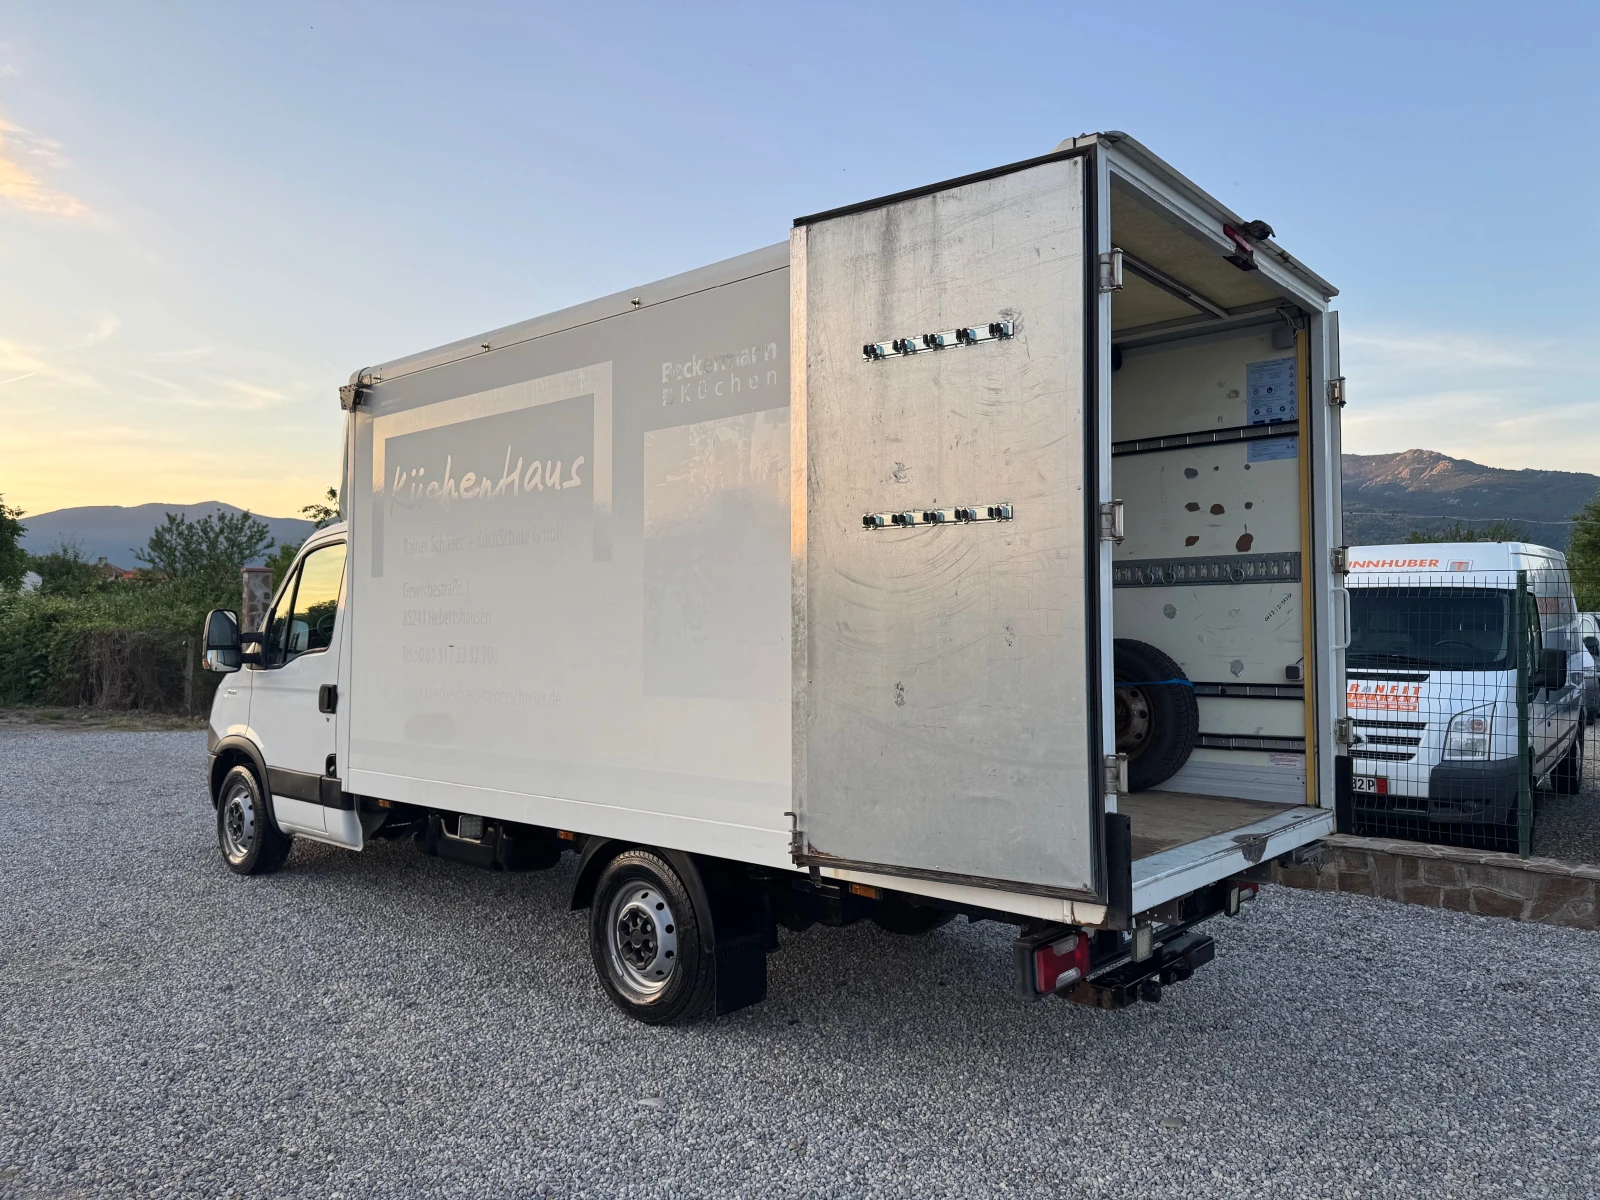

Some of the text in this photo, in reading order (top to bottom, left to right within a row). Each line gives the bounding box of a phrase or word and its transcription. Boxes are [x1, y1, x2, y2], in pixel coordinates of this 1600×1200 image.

[680, 370, 777, 403] Küchen
[390, 444, 585, 517] KüchenHaus
[403, 538, 429, 556] Rainer
[477, 525, 530, 549] KochSchule
[1349, 559, 1440, 569] NNHUBER
[403, 578, 463, 598] Gewerbestraße
[403, 607, 492, 626] 85241 Hebertshausen
